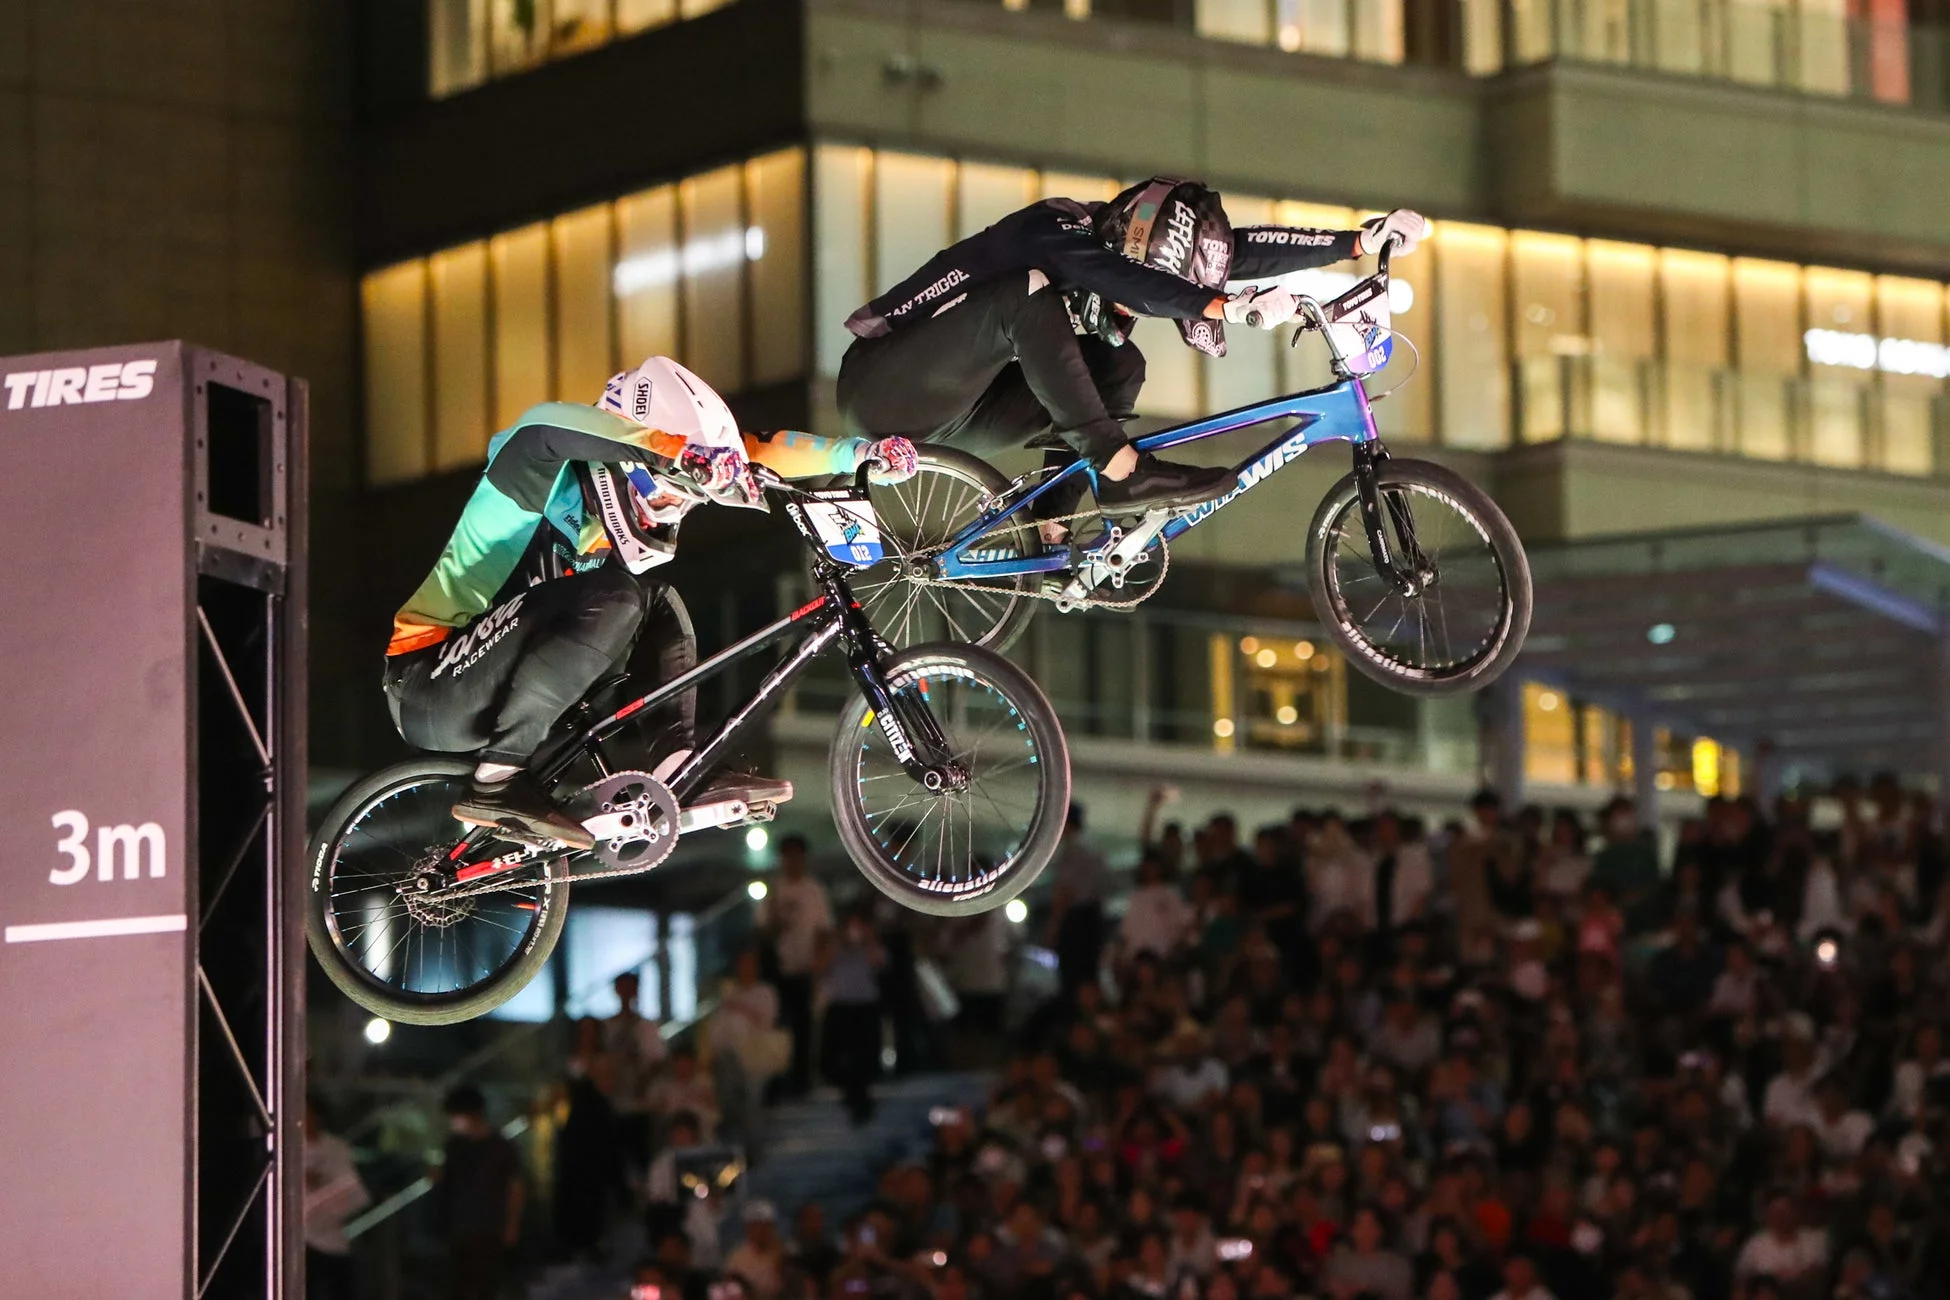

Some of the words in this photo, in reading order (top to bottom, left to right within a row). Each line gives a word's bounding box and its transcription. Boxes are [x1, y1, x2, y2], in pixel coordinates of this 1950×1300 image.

[1247, 231, 1290, 244] TOYO
[1289, 233, 1336, 246] TIRES
[1367, 345, 1387, 369] 002
[4, 360, 158, 410] TIRES
[635, 383, 649, 415] SHOEI
[597, 467, 616, 517] NEMOTO
[609, 517, 629, 546] WORKS
[850, 545, 873, 562] 012
[452, 617, 520, 678] RACEWEAR
[880, 714, 914, 764] CITIZEN
[49, 809, 166, 886] 3m
